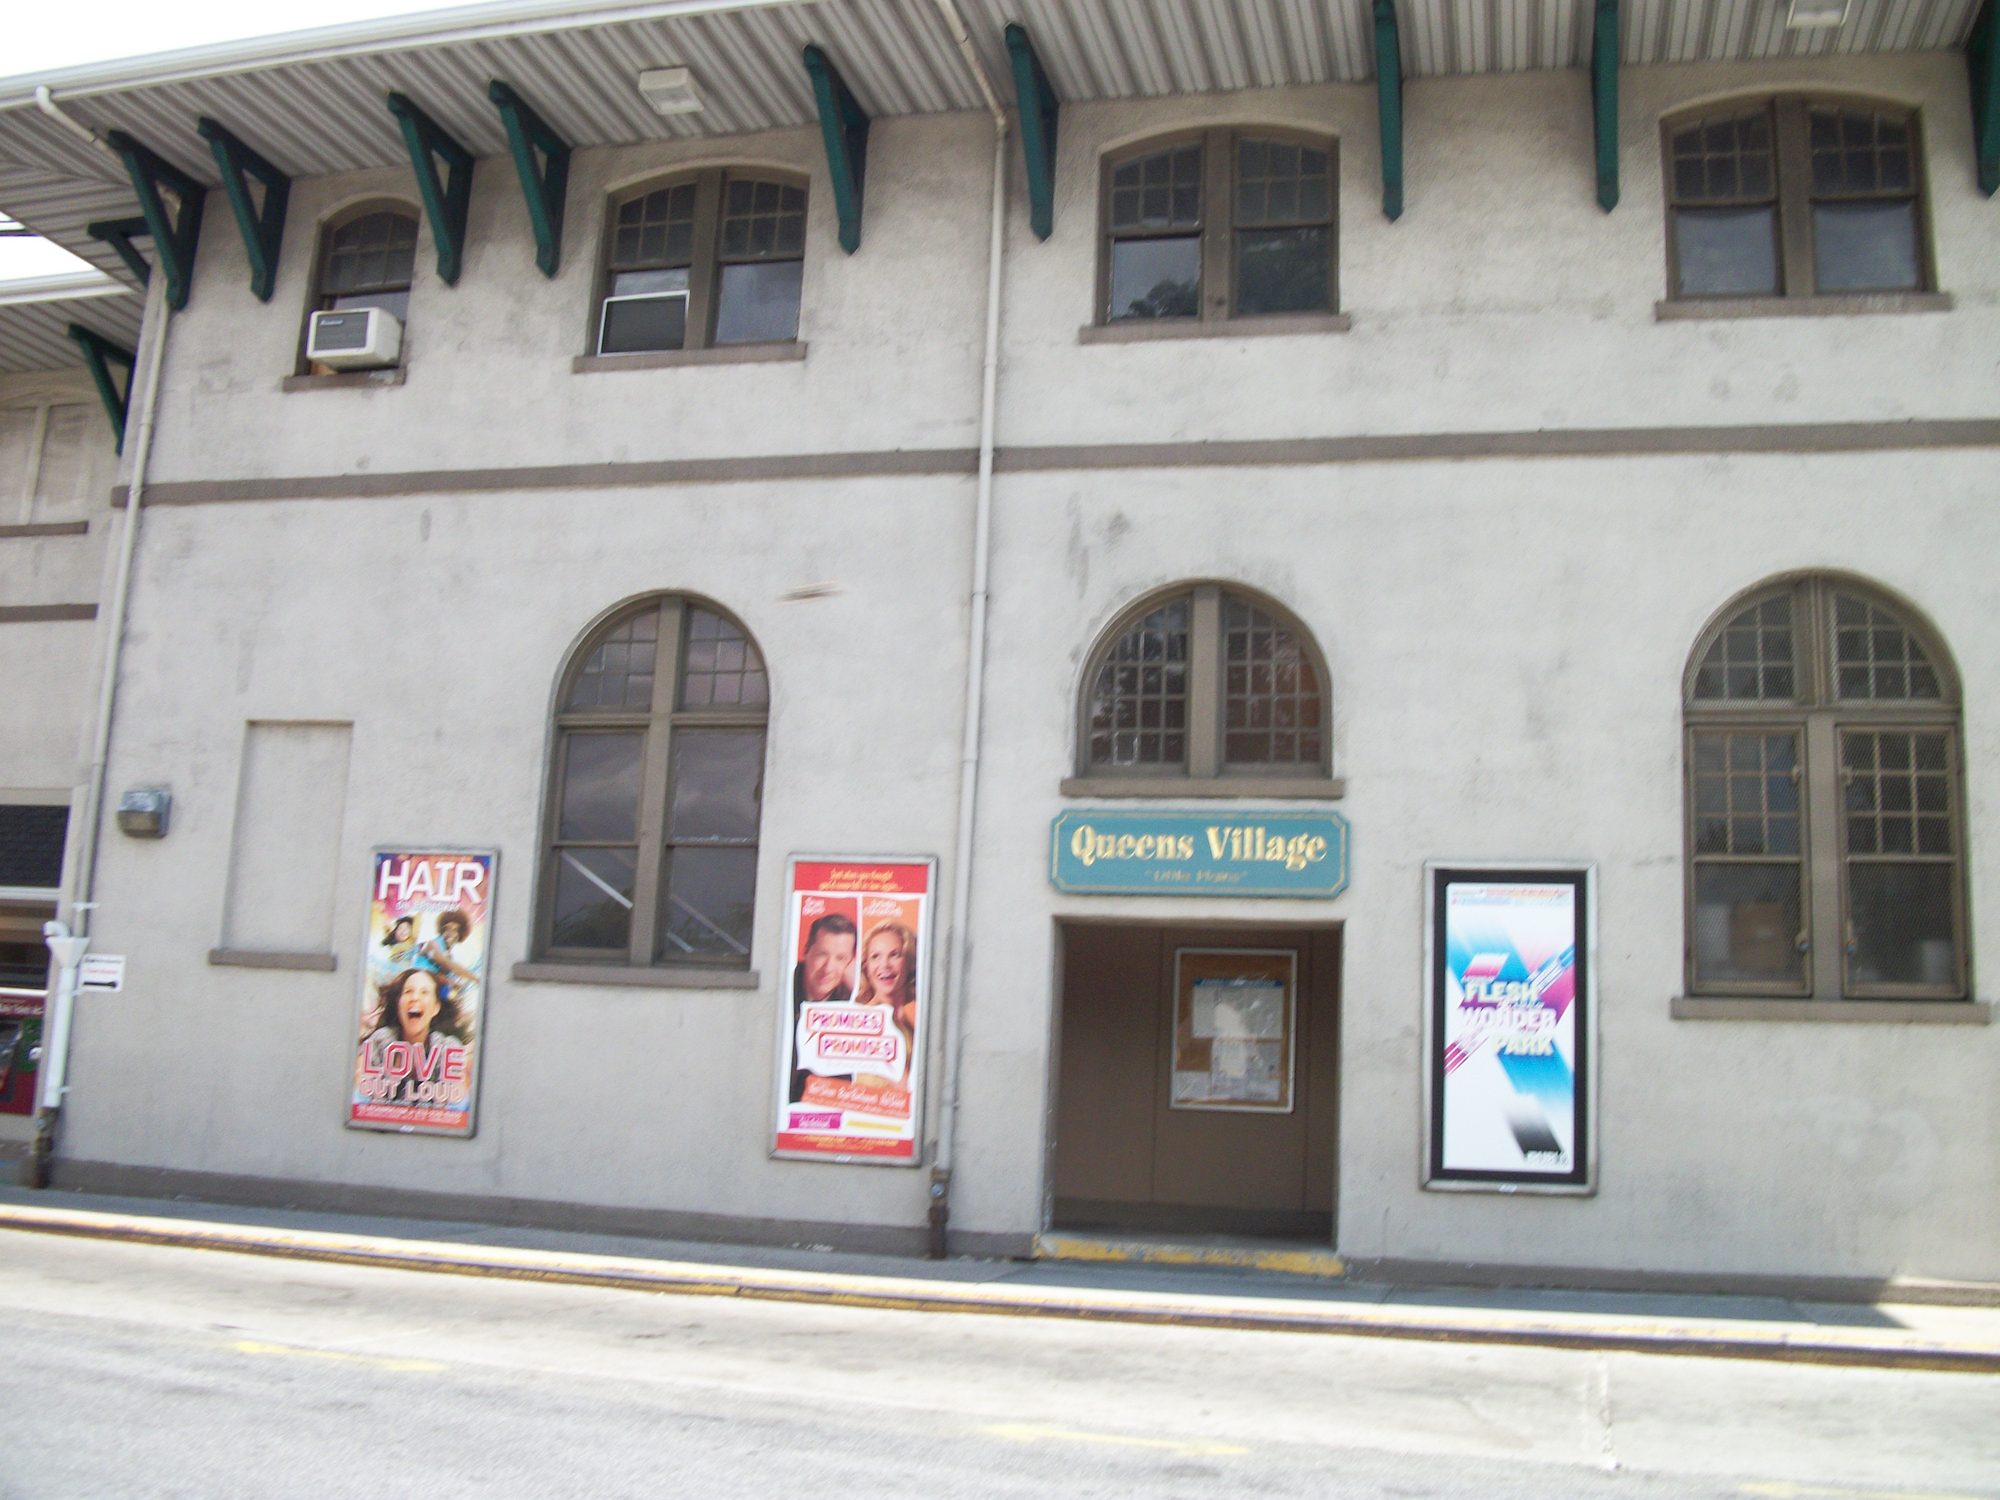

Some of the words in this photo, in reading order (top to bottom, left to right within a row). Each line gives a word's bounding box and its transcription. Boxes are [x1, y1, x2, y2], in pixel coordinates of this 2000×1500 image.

[1071, 824, 1194, 866] Queens
[1206, 825, 1328, 871] Village
[379, 859, 484, 904] HAIR
[1464, 980, 1538, 1002] FLESH
[1458, 1008, 1556, 1031] WONDER
[823, 1040, 894, 1057] PROMISES
[1494, 1036, 1554, 1055] PARK
[363, 1040, 466, 1081] LOVE
[359, 1077, 400, 1100] OUT
[405, 1081, 465, 1104] LOUD
